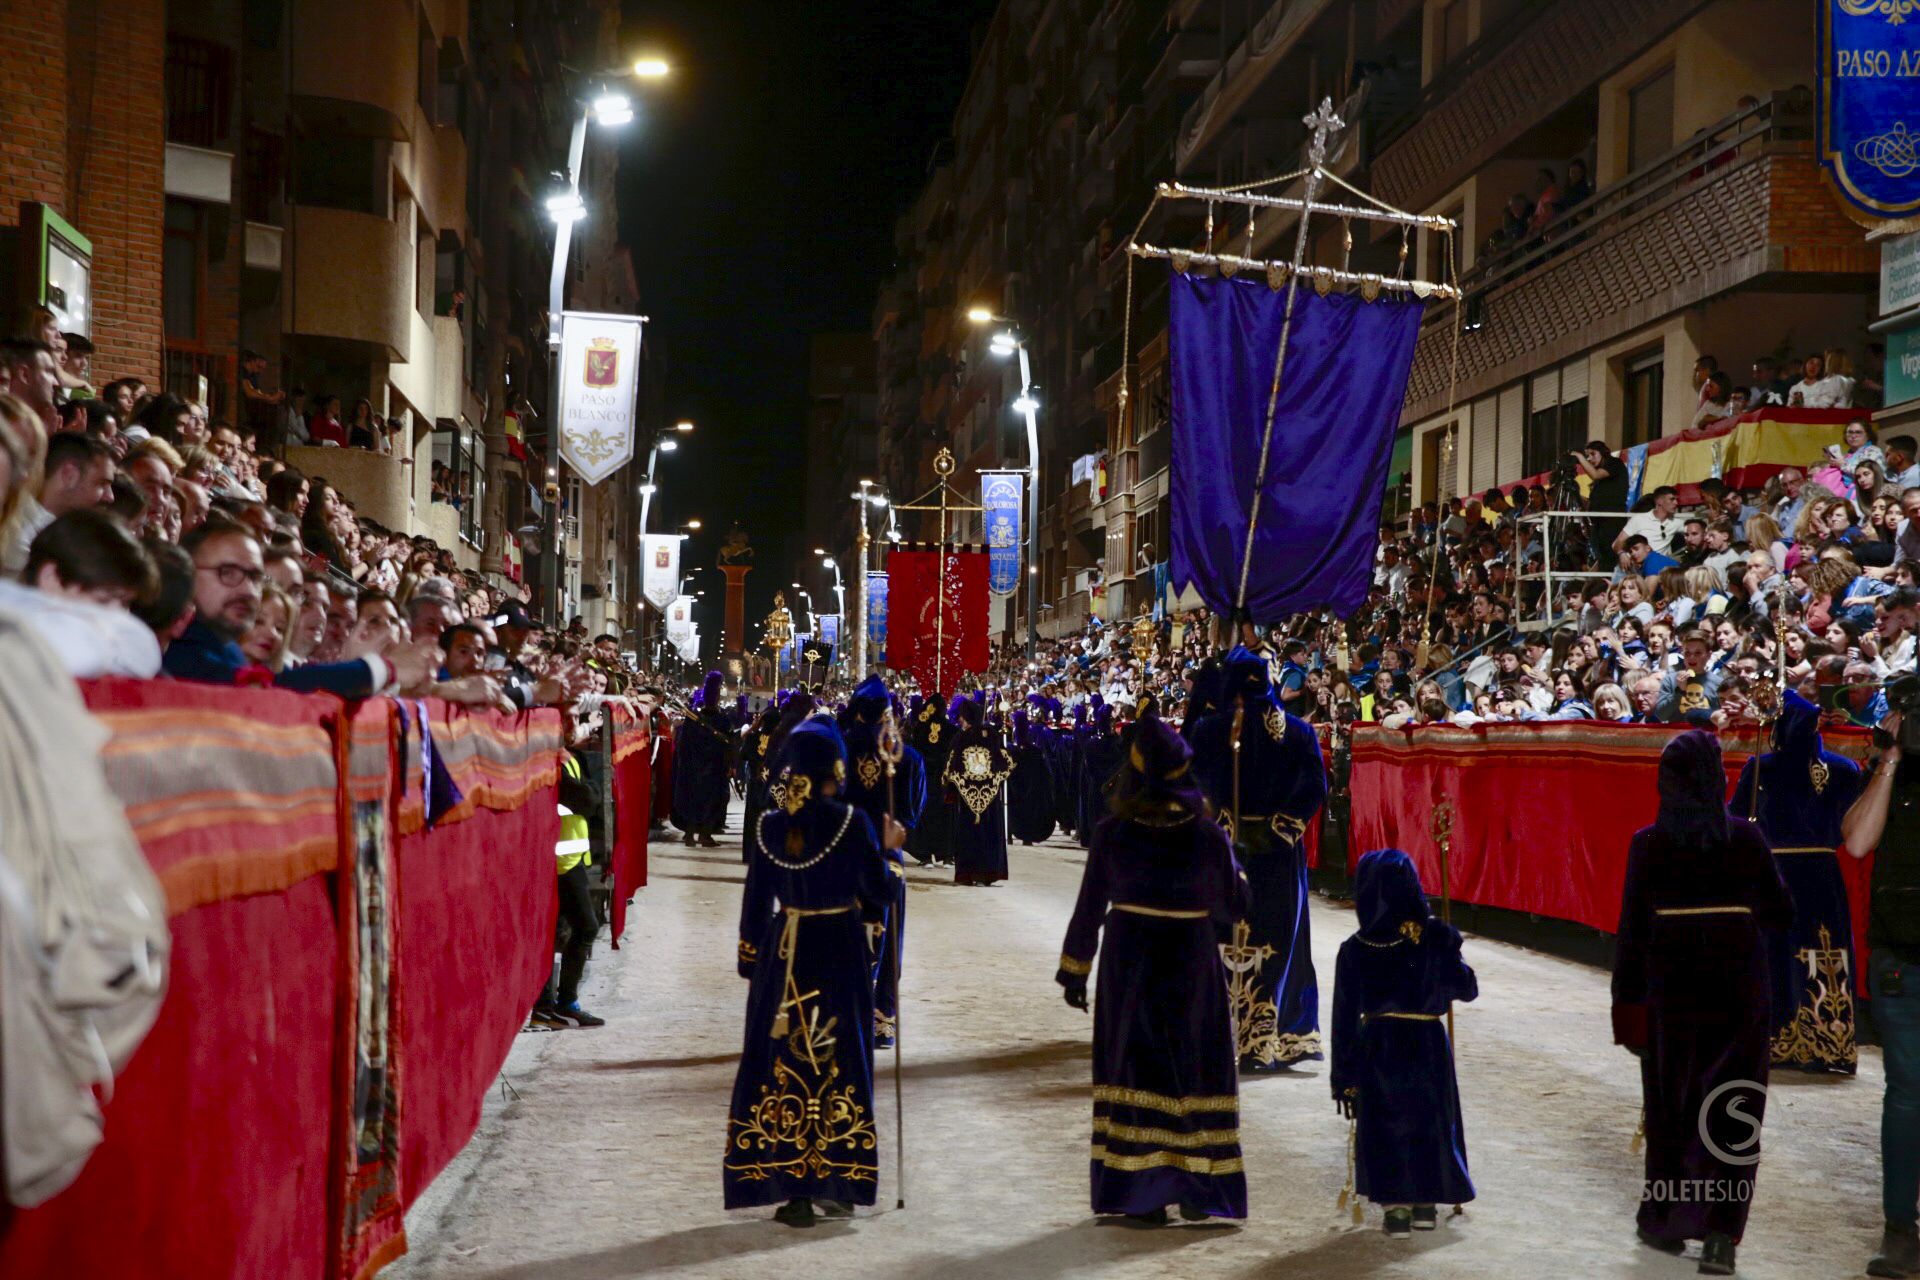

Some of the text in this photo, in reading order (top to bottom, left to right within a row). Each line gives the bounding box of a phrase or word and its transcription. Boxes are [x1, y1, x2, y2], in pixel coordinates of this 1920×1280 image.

[1837, 49, 1891, 77] PASO
[582, 393, 616, 406] PASO
[569, 408, 626, 422] BLANCO
